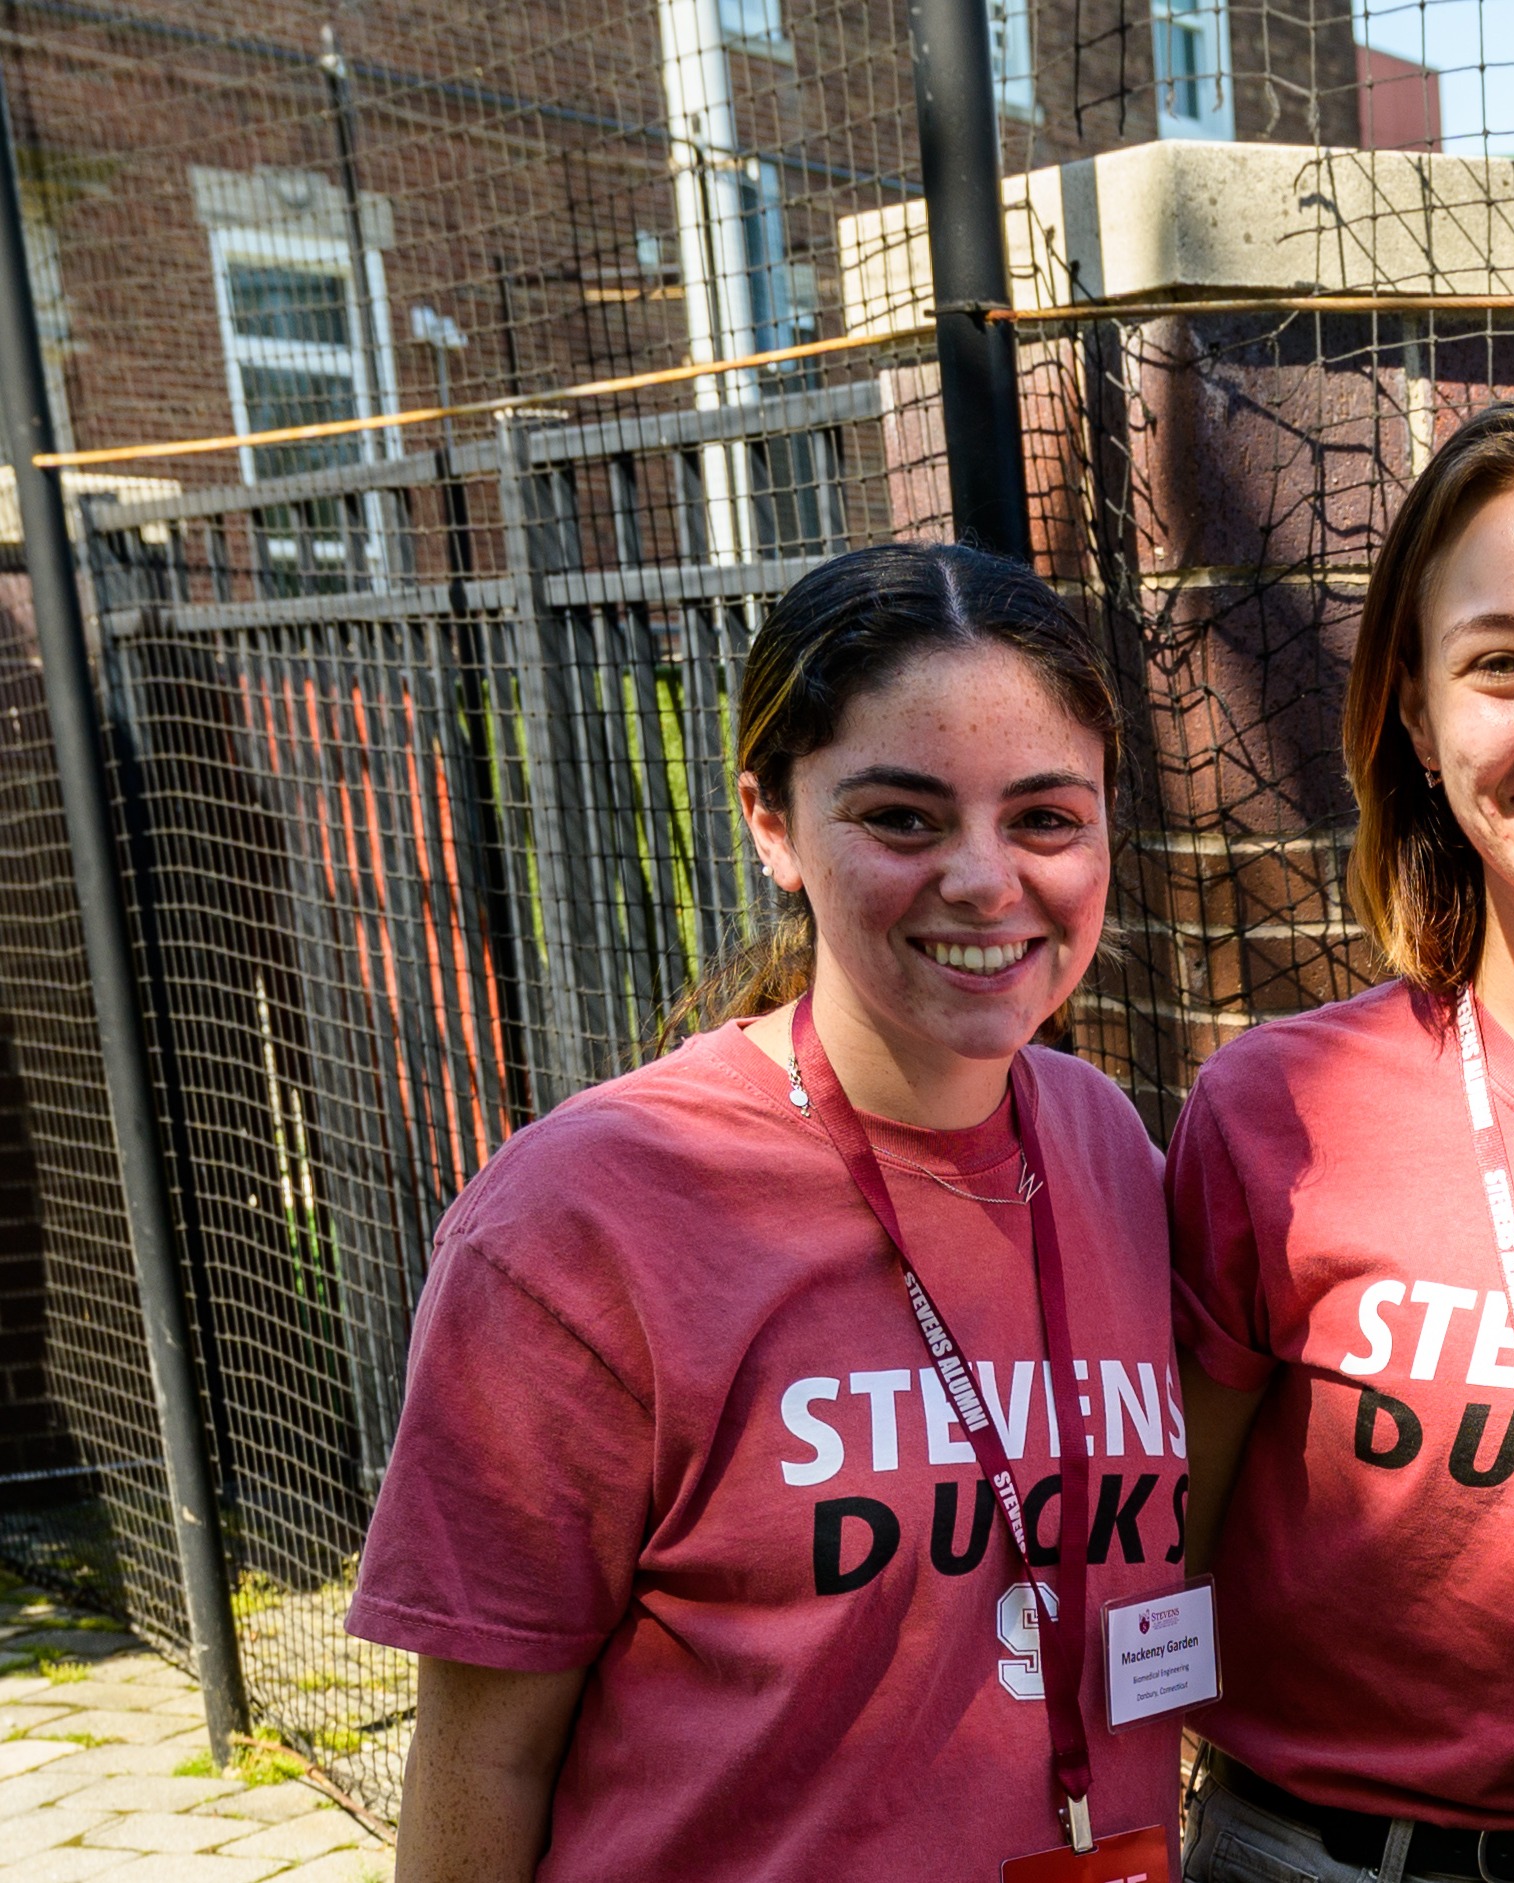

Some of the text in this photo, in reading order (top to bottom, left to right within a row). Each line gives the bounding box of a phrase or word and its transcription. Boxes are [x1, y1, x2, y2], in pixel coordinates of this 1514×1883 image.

[904, 1271, 990, 1432] STEVENS ALUMNI
[780, 1360, 1188, 1487] STEVENS
[994, 1470, 1027, 1555] STEVENS
[1151, 1608, 1180, 1622] STEVENS
[1121, 1635, 1199, 1666] Mackenzy Garden
[1133, 1664, 1190, 1684] Biomedical Engineering
